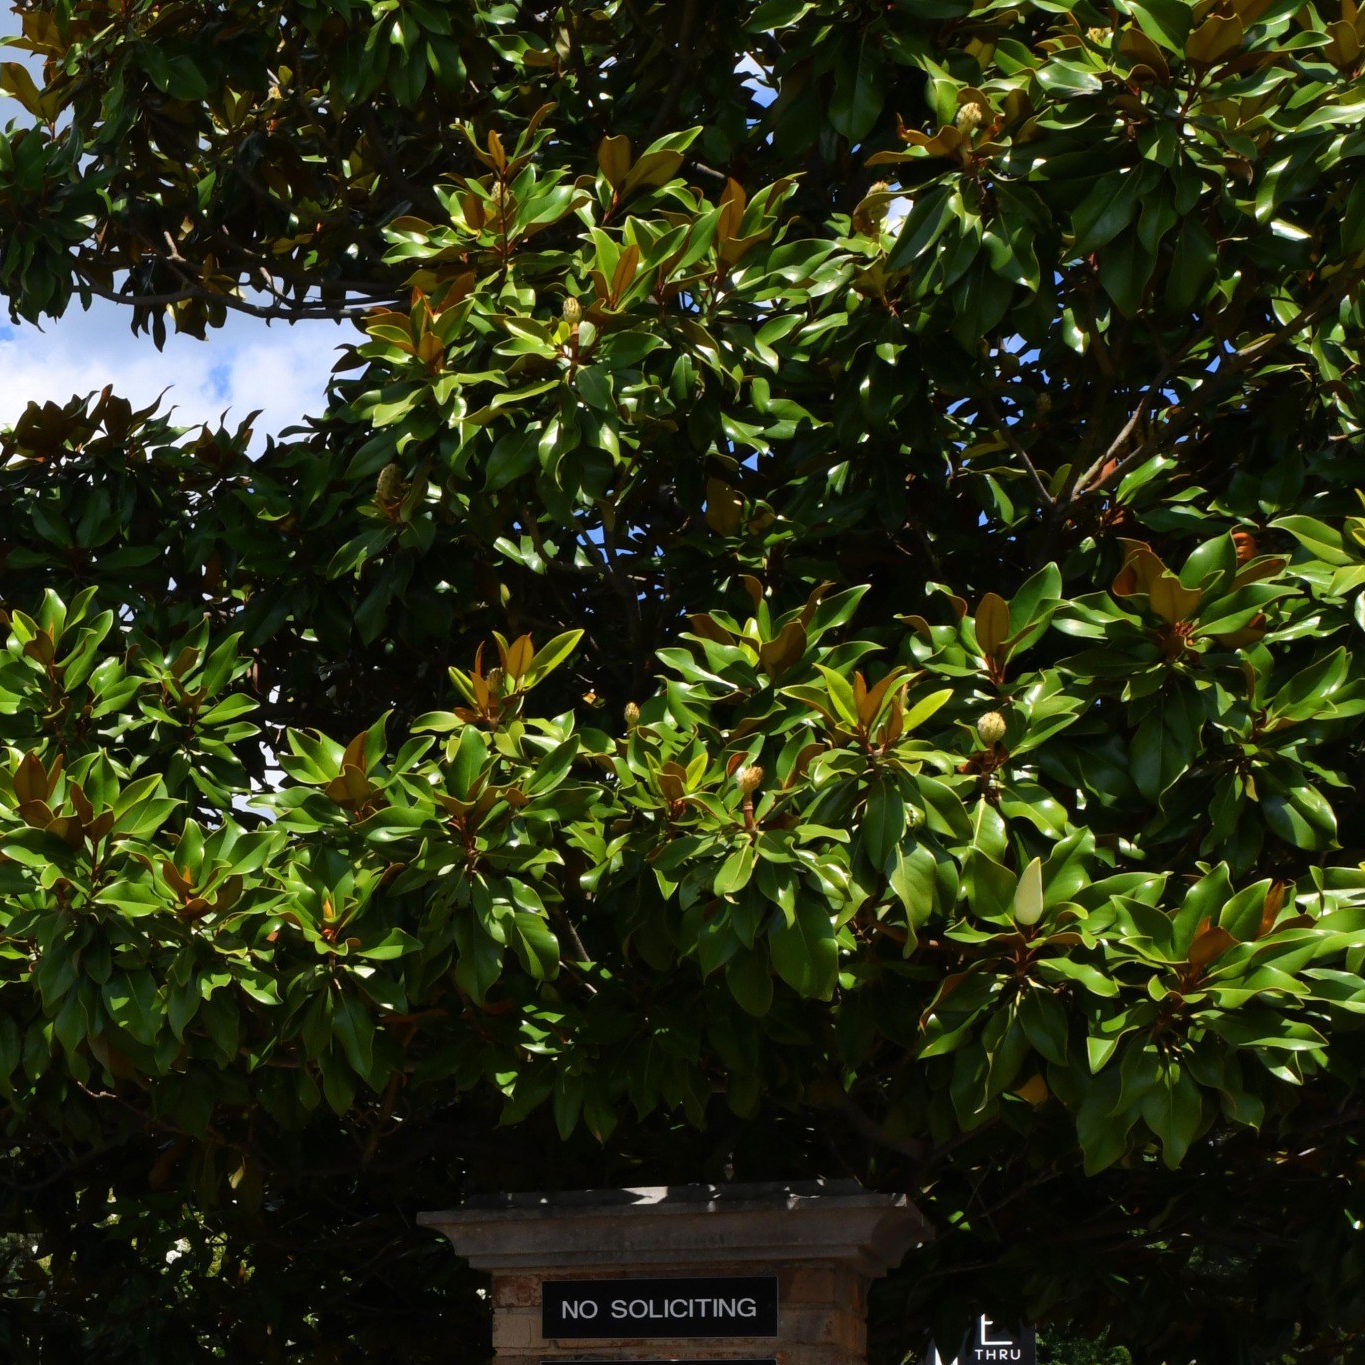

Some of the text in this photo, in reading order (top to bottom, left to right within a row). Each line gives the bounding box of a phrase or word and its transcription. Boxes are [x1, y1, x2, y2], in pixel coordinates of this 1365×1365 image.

[561, 1297, 757, 1319] NO SOLICITING
[974, 1348, 1021, 1361] THRU
